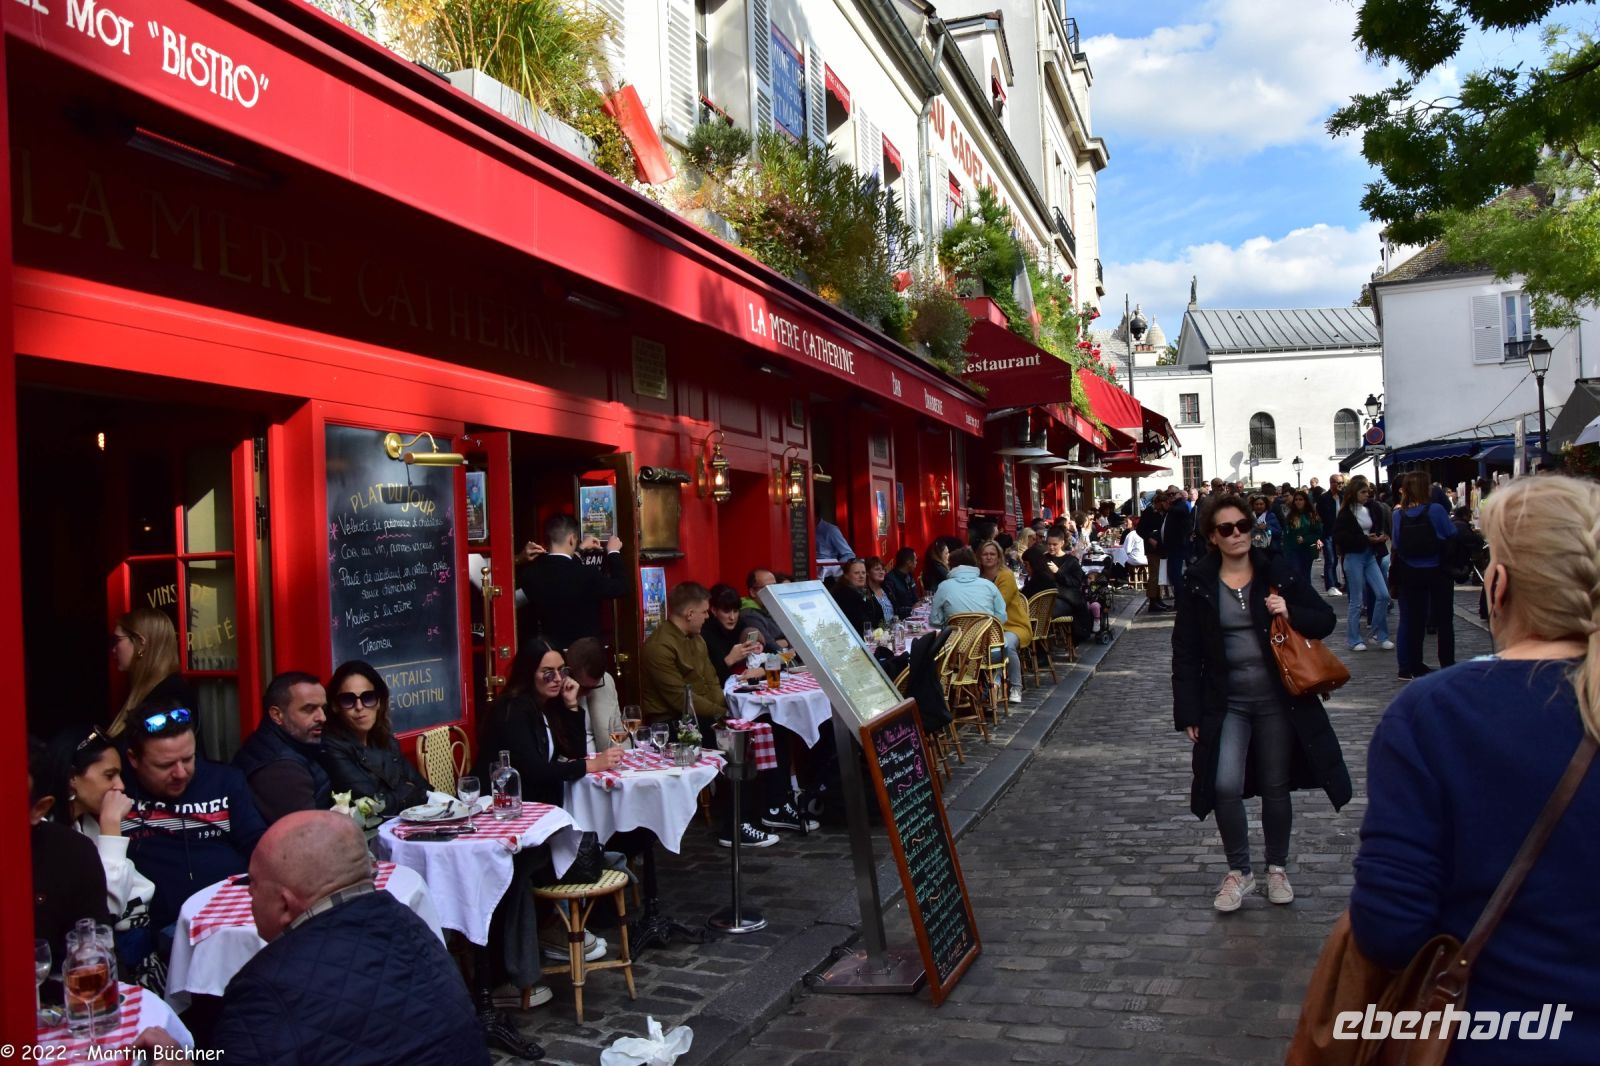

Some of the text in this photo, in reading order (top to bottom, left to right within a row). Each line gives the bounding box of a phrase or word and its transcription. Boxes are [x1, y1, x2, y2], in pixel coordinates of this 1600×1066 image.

[66, 0, 269, 108] MOT "BISTRO"
[929, 97, 945, 141] AU
[951, 120, 982, 188] CADET
[19, 147, 125, 251] LA
[748, 303, 855, 375] LA MERE CATHERINE
[350, 484, 384, 514] PLAT
[401, 486, 436, 518] JOUR
[384, 667, 433, 690] CKTAILS
[399, 686, 445, 710] CONTINU
[198, 829, 223, 839] 1990
